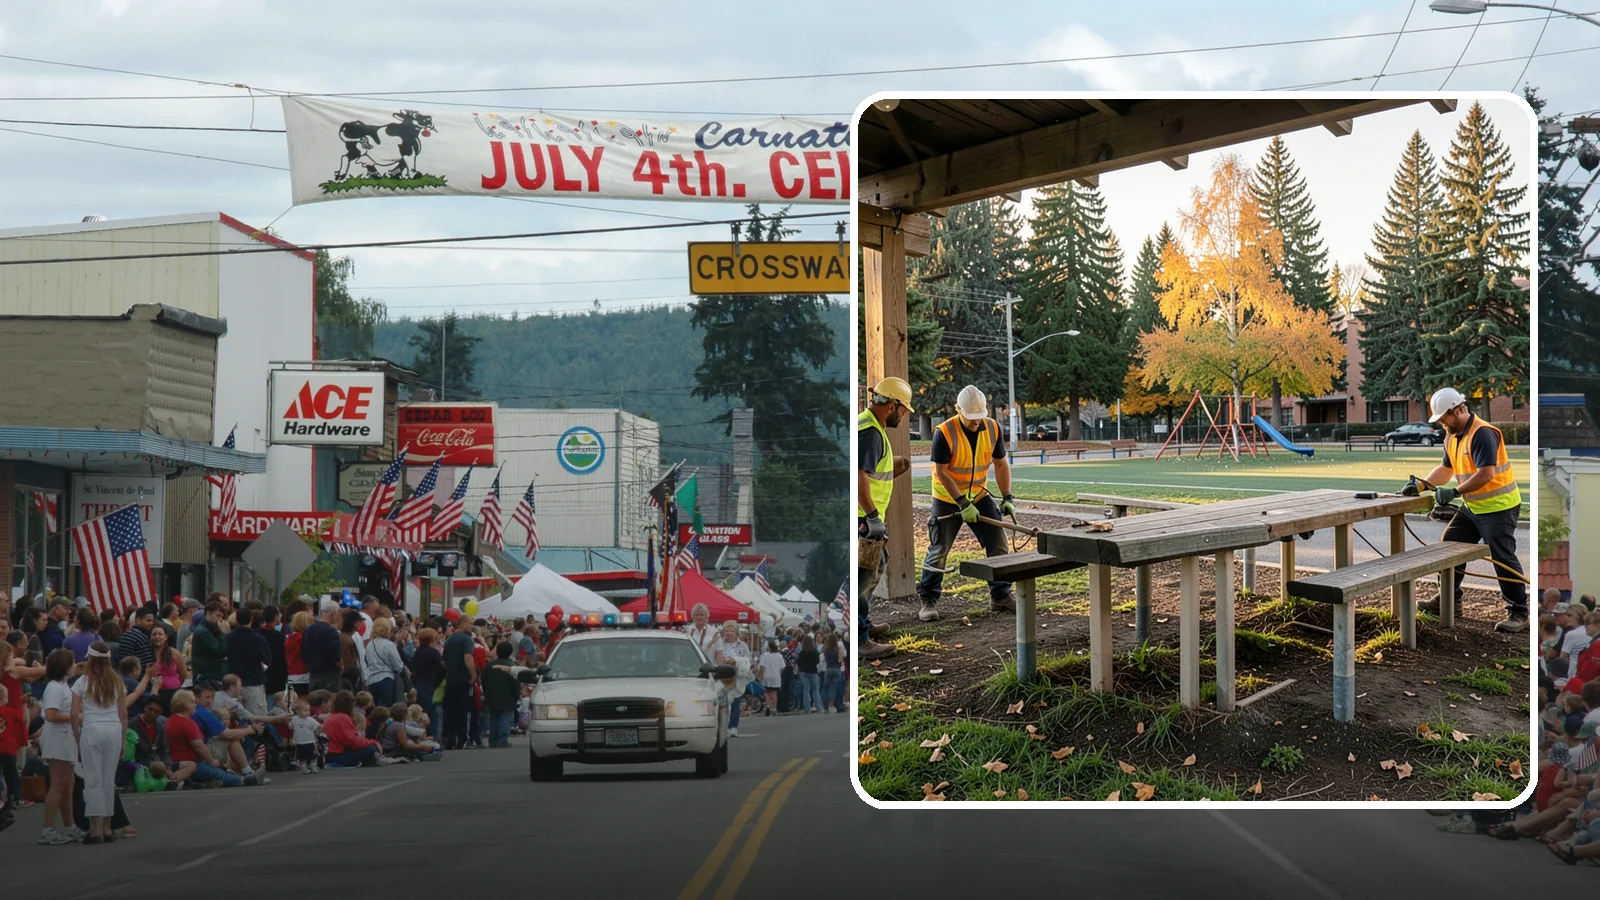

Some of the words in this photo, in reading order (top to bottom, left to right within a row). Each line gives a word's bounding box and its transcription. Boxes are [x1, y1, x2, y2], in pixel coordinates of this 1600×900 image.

[481, 141, 605, 192] JULY
[632, 149, 747, 198] 4th.
[282, 380, 374, 420] ACE
[406, 409, 453, 422] CEDAR
[283, 421, 371, 436] Hardware
[416, 428, 477, 447] Coca-Cola
[83, 484, 94, 494] St.
[95, 485, 124, 495] Vincent
[126, 486, 136, 495] de
[137, 486, 155, 495] Paul
[688, 526, 742, 535] CRNATION
[699, 535, 731, 543] GLASS
